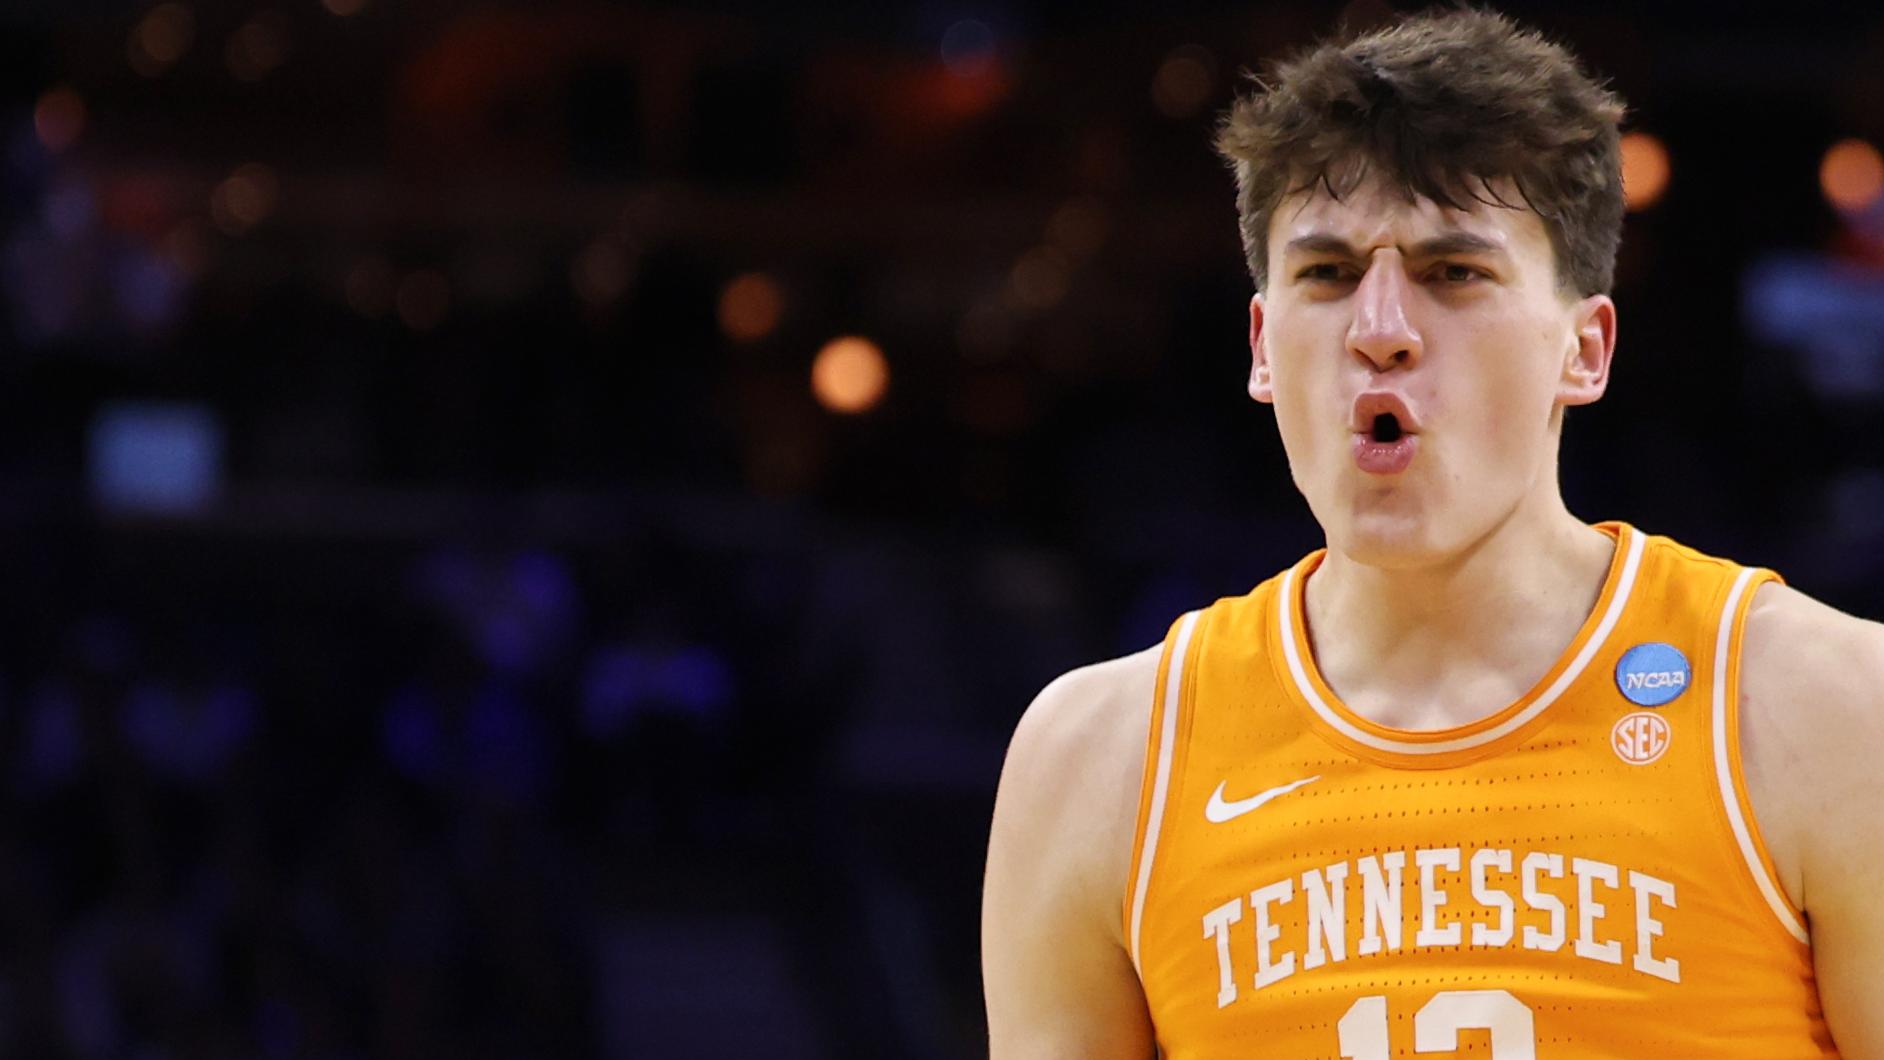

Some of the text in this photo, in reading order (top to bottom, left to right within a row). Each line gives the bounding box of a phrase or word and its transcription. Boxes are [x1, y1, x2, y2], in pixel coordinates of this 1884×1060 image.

[1626, 671, 1686, 689] NCAA
[1615, 716, 1666, 760] SEC
[1202, 847, 1681, 1008] TENNESSEE
